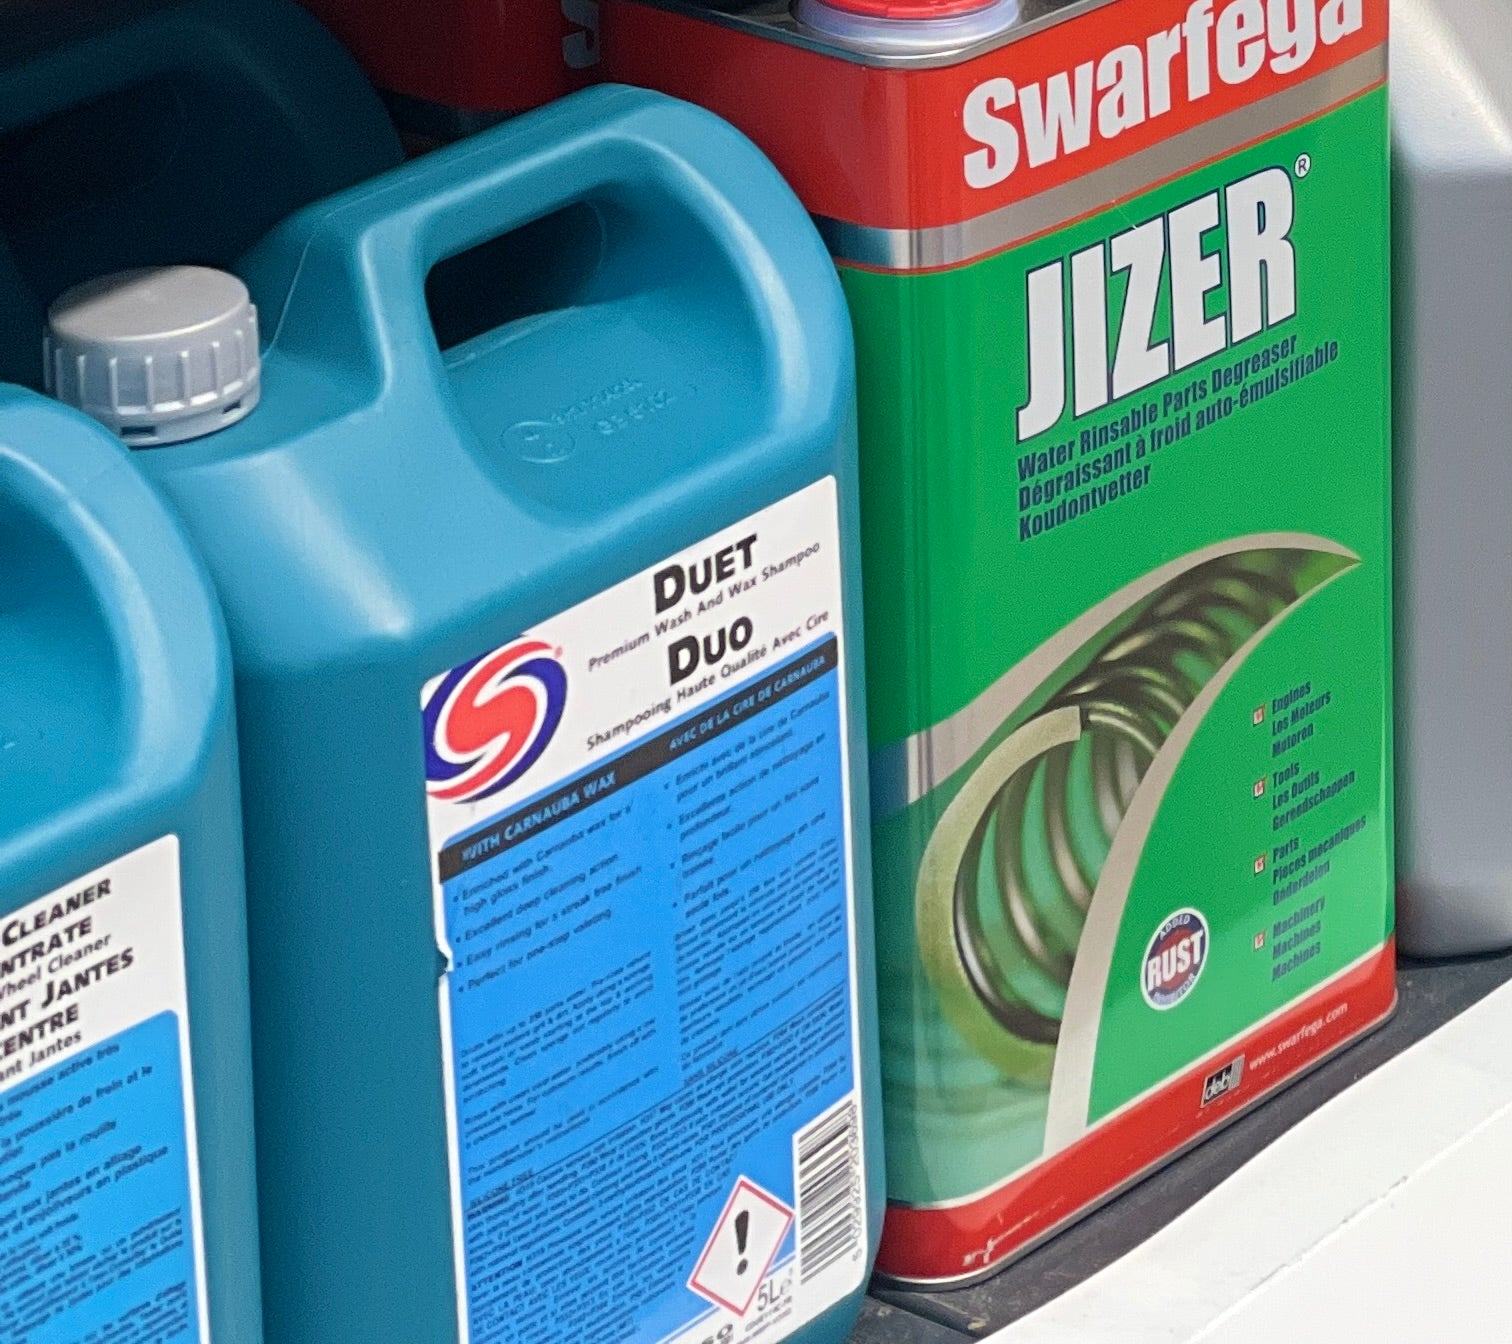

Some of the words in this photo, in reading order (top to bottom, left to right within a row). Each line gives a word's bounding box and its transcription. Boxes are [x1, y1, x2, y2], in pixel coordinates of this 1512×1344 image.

[1015, 165, 1298, 444] JIZER
[1017, 439, 1076, 481] Water
[1079, 403, 1158, 457] Rinsable
[1162, 379, 1207, 417] Parts
[1212, 334, 1298, 393] Degreaser
[1018, 443, 1132, 513] Dégraissant
[1150, 415, 1191, 450] froid
[1195, 341, 1338, 429] auto-émulsifiable
[1019, 463, 1152, 542] Koudontvetter
[654, 532, 758, 615] DUET
[587, 632, 650, 673] Premium
[654, 611, 692, 641] Wash
[697, 591, 723, 617] And
[728, 576, 757, 601] Wax
[761, 541, 820, 583] Shampoo
[586, 695, 671, 752] Shampooing
[676, 673, 716, 705] Haute
[720, 643, 767, 678] Qualité
[772, 626, 802, 653] Avec
[806, 610, 829, 634] Cire
[668, 615, 754, 686] DUO
[669, 727, 696, 751] AVEC
[700, 717, 714, 735] DE
[717, 709, 730, 725] LA
[733, 698, 755, 716] CIRE
[758, 689, 772, 703] DE
[774, 654, 827, 692] CARNAUBA
[1272, 681, 1311, 714] Engines
[1273, 762, 1299, 788] Tools
[1291, 771, 1320, 796] Outils
[461, 832, 500, 862] WITH
[504, 791, 580, 840] CARNAUBA
[583, 770, 616, 798] WAX
[536, 831, 585, 862] Carnauba
[1273, 837, 1299, 863] Parts
[1273, 896, 1325, 939] Machinery
[1273, 920, 1321, 960] Machines
[41, 947, 134, 1009] JANTES
[48, 934, 111, 973] Cleaner
[1148, 930, 1203, 991] RUST
[1272, 941, 1321, 984] Machines
[0, 1003, 79, 1060] ENTRE
[30, 1031, 82, 1067] Jantes
[1205, 1063, 1232, 1101] deb
[1250, 1002, 1348, 1071] www.swarfega.com
